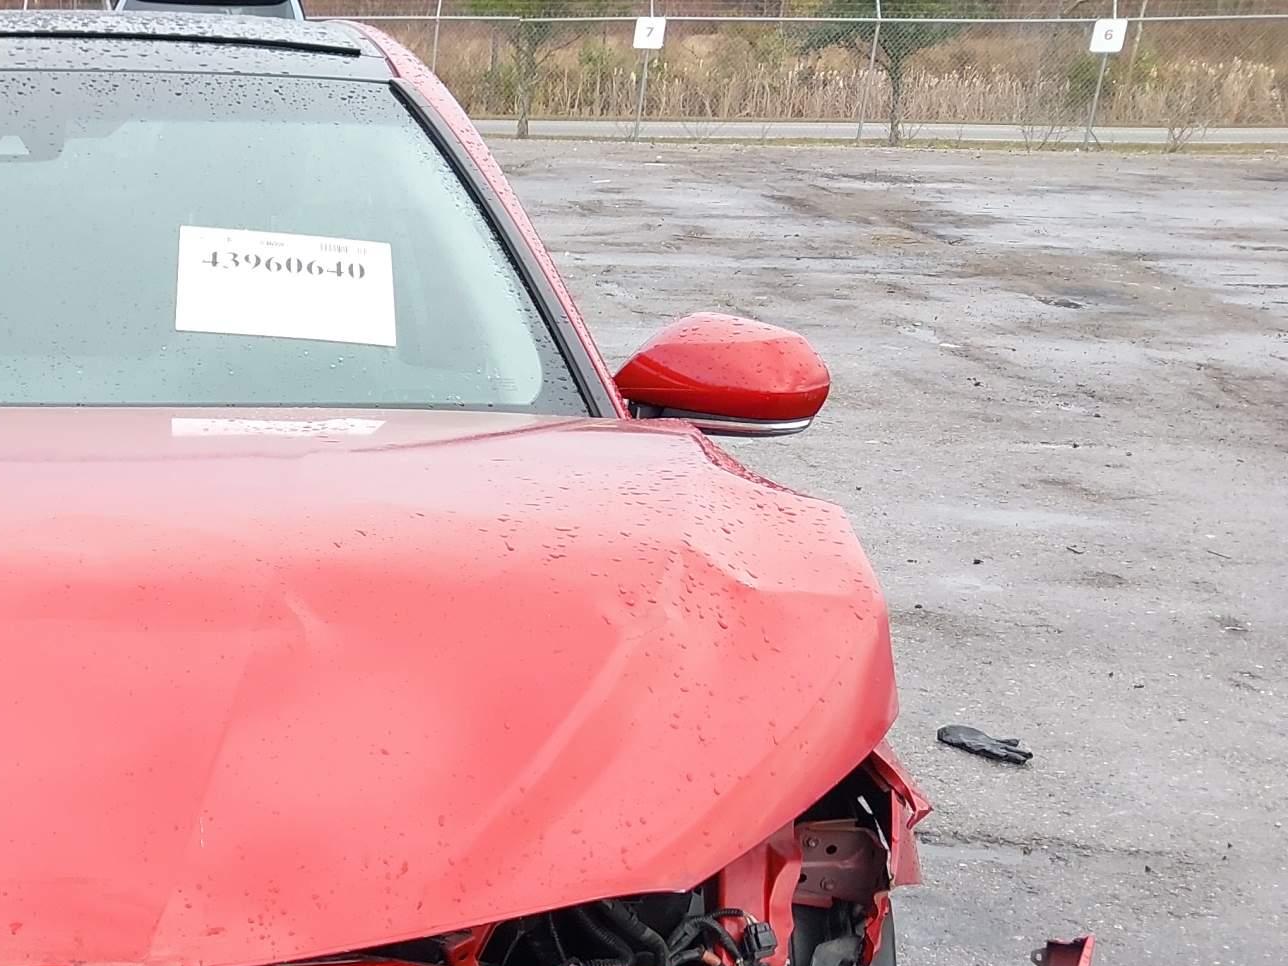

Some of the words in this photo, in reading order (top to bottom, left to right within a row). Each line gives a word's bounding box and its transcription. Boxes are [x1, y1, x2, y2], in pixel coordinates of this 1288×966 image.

[646, 27, 654, 37] 7
[1104, 30, 1113, 40] 6
[201, 250, 366, 280] 43960640
